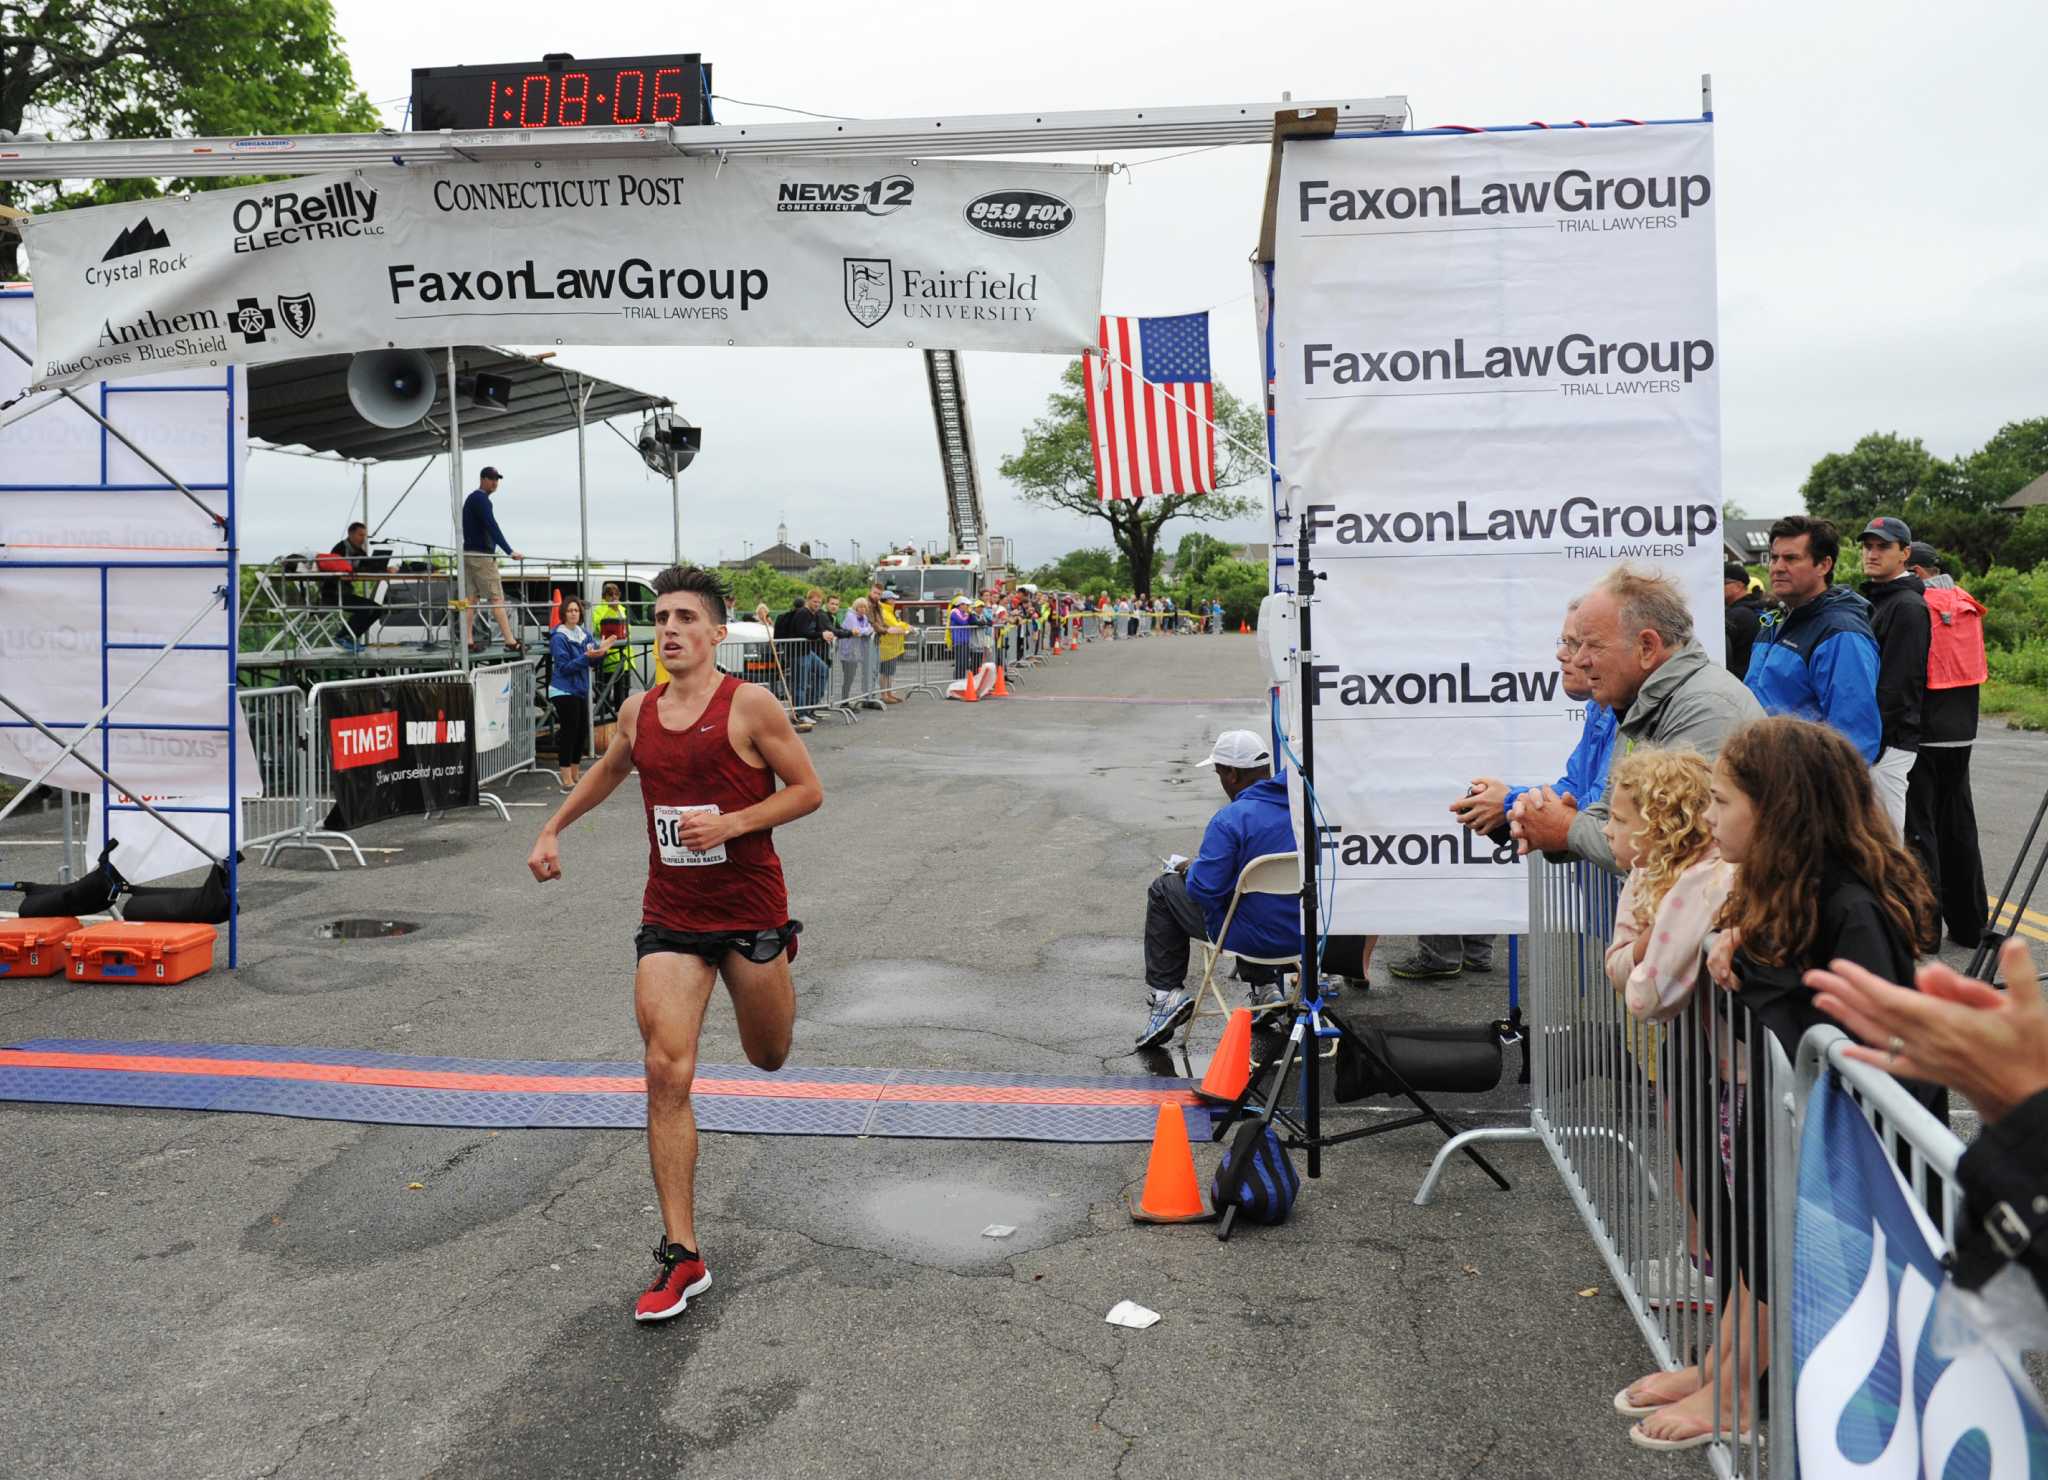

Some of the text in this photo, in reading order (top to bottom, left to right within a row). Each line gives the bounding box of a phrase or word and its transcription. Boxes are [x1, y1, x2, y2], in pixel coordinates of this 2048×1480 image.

[433, 174, 685, 212] CONNECTICUT POST
[777, 179, 915, 206] NEWS 12
[779, 203, 857, 212] CONNECTICUT
[1299, 169, 1711, 222] FaxonLawGroup
[981, 219, 1057, 231] CLASSIC ROCK
[1025, 203, 1070, 222] FOX
[1557, 215, 1678, 233] TRIAL LAWYERS
[234, 219, 385, 254] ELECTRIC LLC
[85, 256, 188, 288] Crystal Rock
[388, 258, 769, 311] FaxonLawGroup
[902, 269, 1039, 301] Fairfield
[97, 309, 220, 348] Anthem
[622, 306, 728, 320] TRIAL LAWYERS
[903, 303, 1038, 322] UNIVERSITY
[46, 335, 228, 377] BlueCross BlueShield
[1303, 333, 1715, 385] FaxonLawGroup
[1560, 379, 1681, 396] TRIAL LAWYERS
[1307, 496, 1718, 547] FaxonLawGroup
[1563, 543, 1685, 560] TRIAL LAWYERS
[1312, 662, 1588, 706] FaxonLaw
[338, 724, 393, 756] TIMEX
